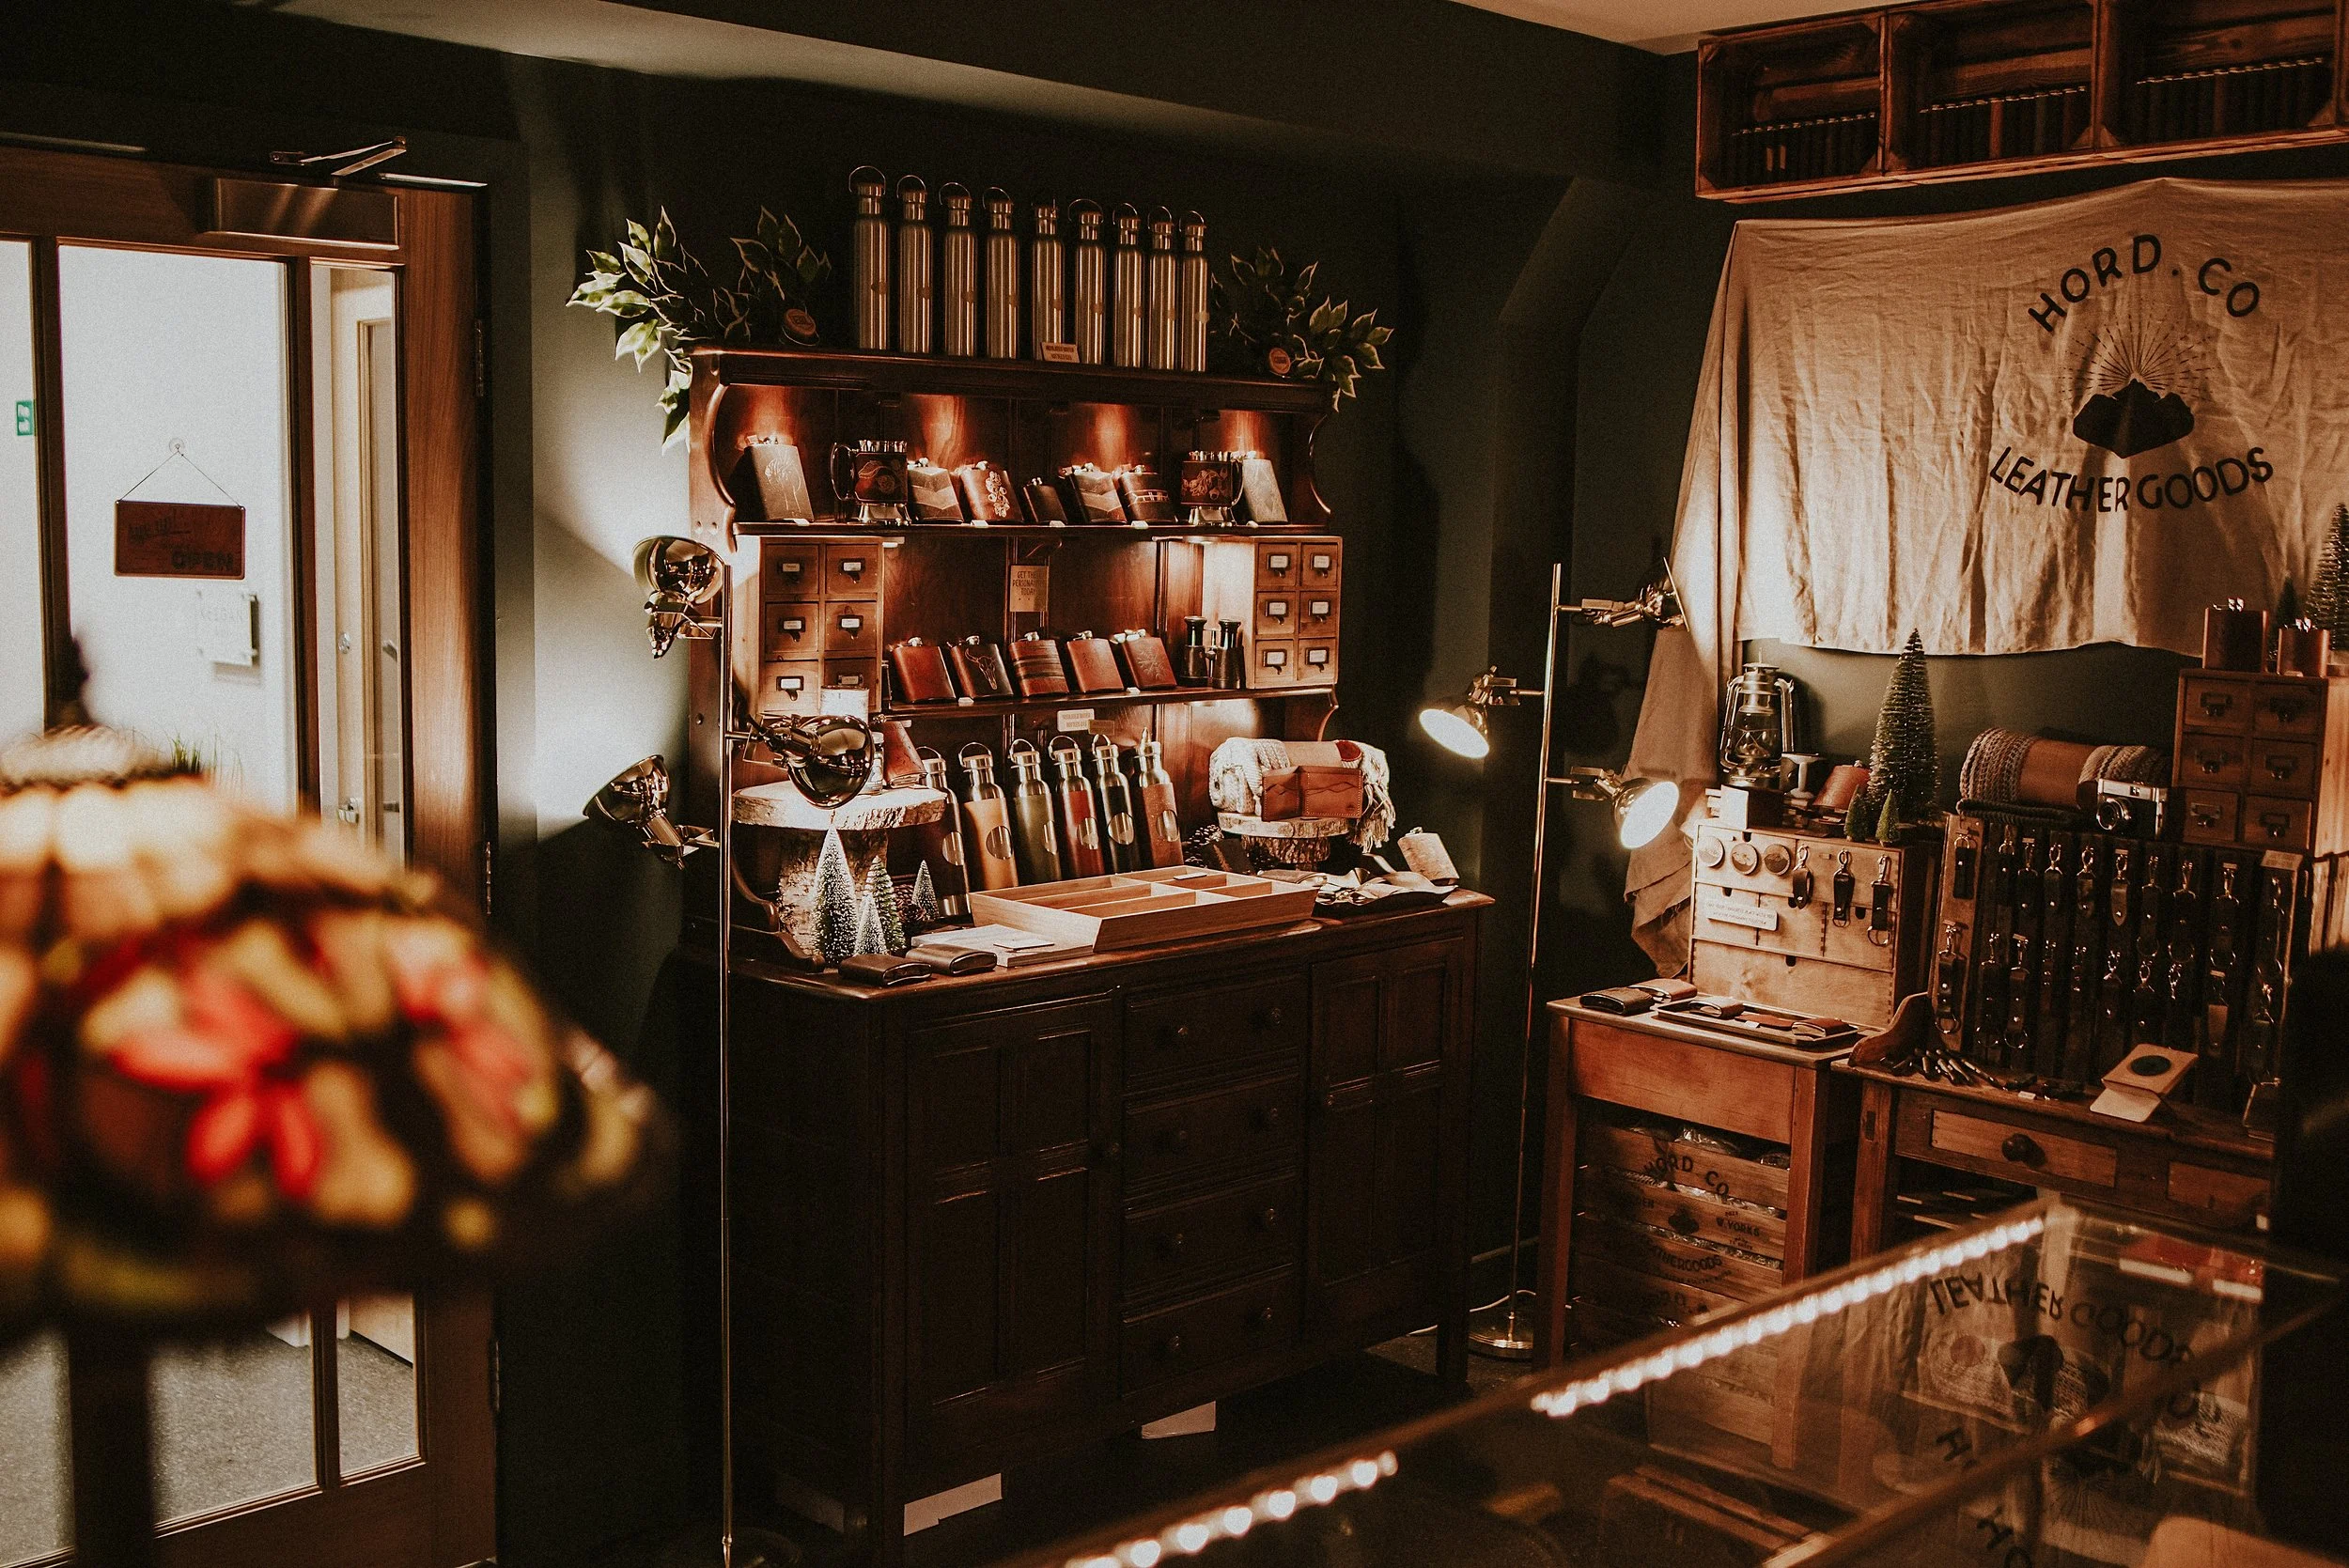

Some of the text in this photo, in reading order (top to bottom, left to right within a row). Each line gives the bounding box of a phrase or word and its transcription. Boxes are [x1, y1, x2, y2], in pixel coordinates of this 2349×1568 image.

[1989, 446, 2274, 512] LEATHER GOODS
[171, 550, 234, 571] OPEN
[1642, 1155, 1694, 1179] HORD
